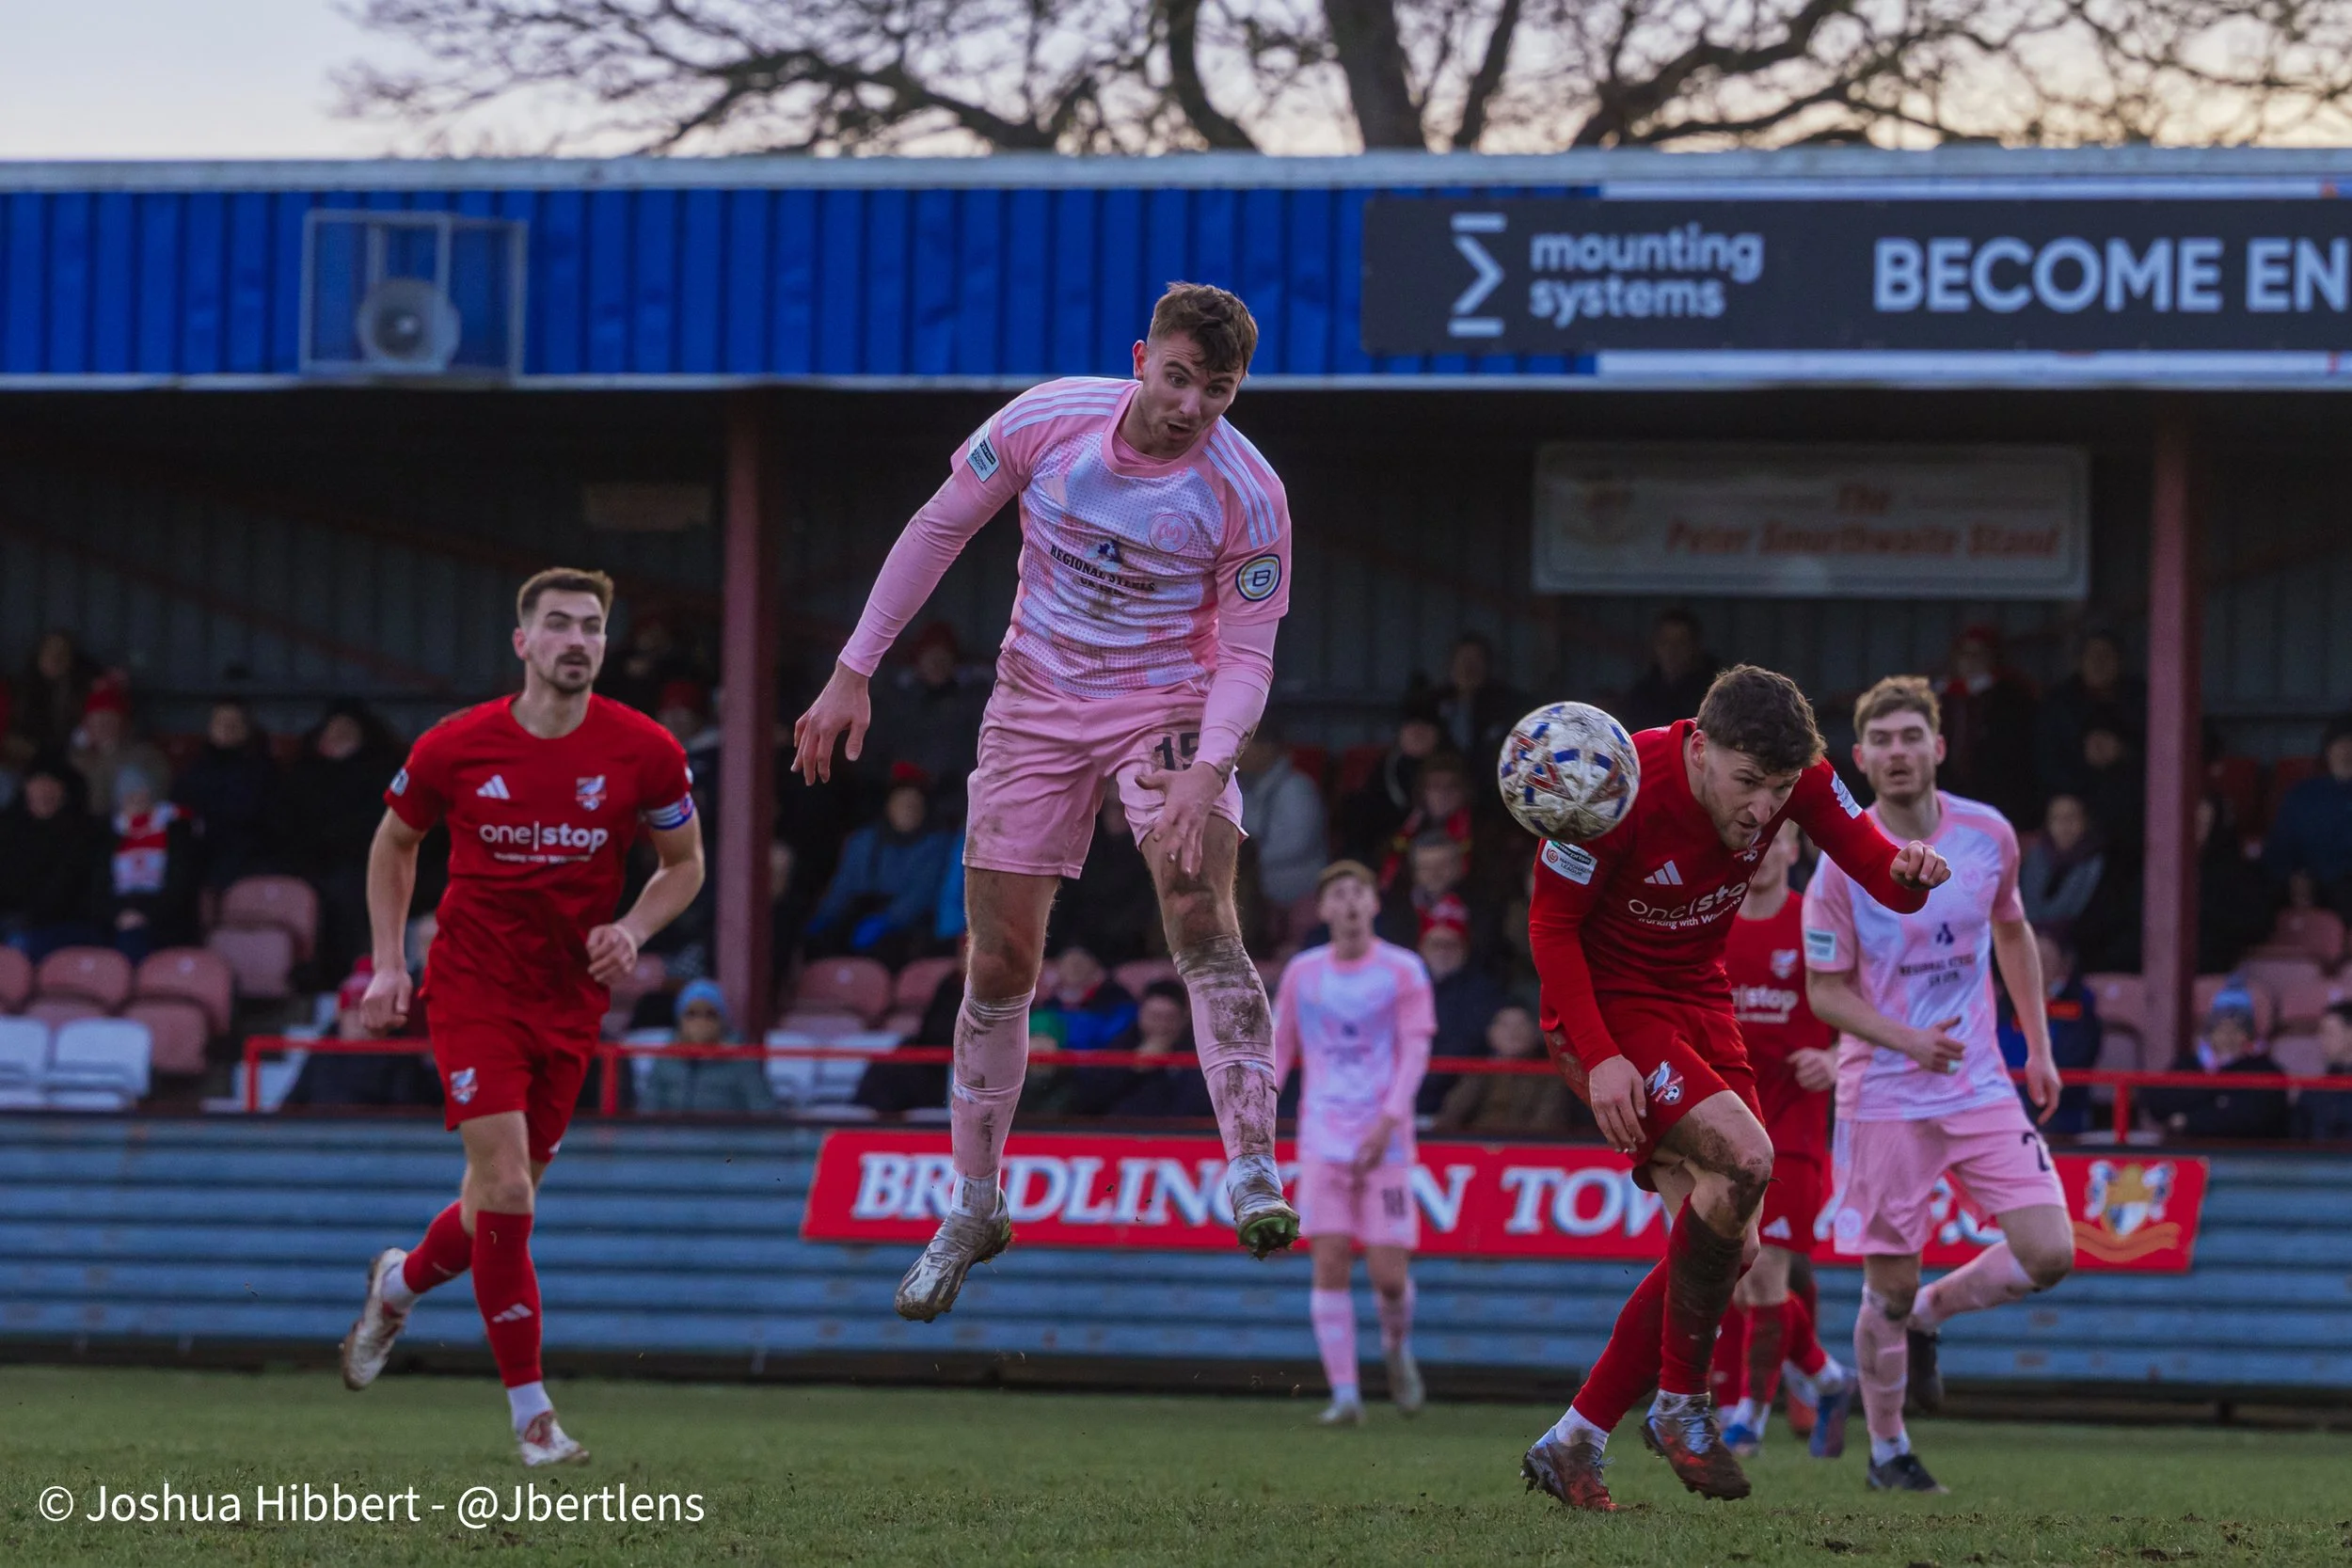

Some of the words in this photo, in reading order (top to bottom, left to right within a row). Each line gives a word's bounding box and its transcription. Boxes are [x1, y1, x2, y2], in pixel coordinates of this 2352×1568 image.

[1531, 224, 1762, 284] mounting
[1874, 238, 2222, 313] BECOME
[2248, 238, 2350, 313] EN
[1530, 271, 1724, 327] systems
[1050, 544, 1106, 579] REGIONAL
